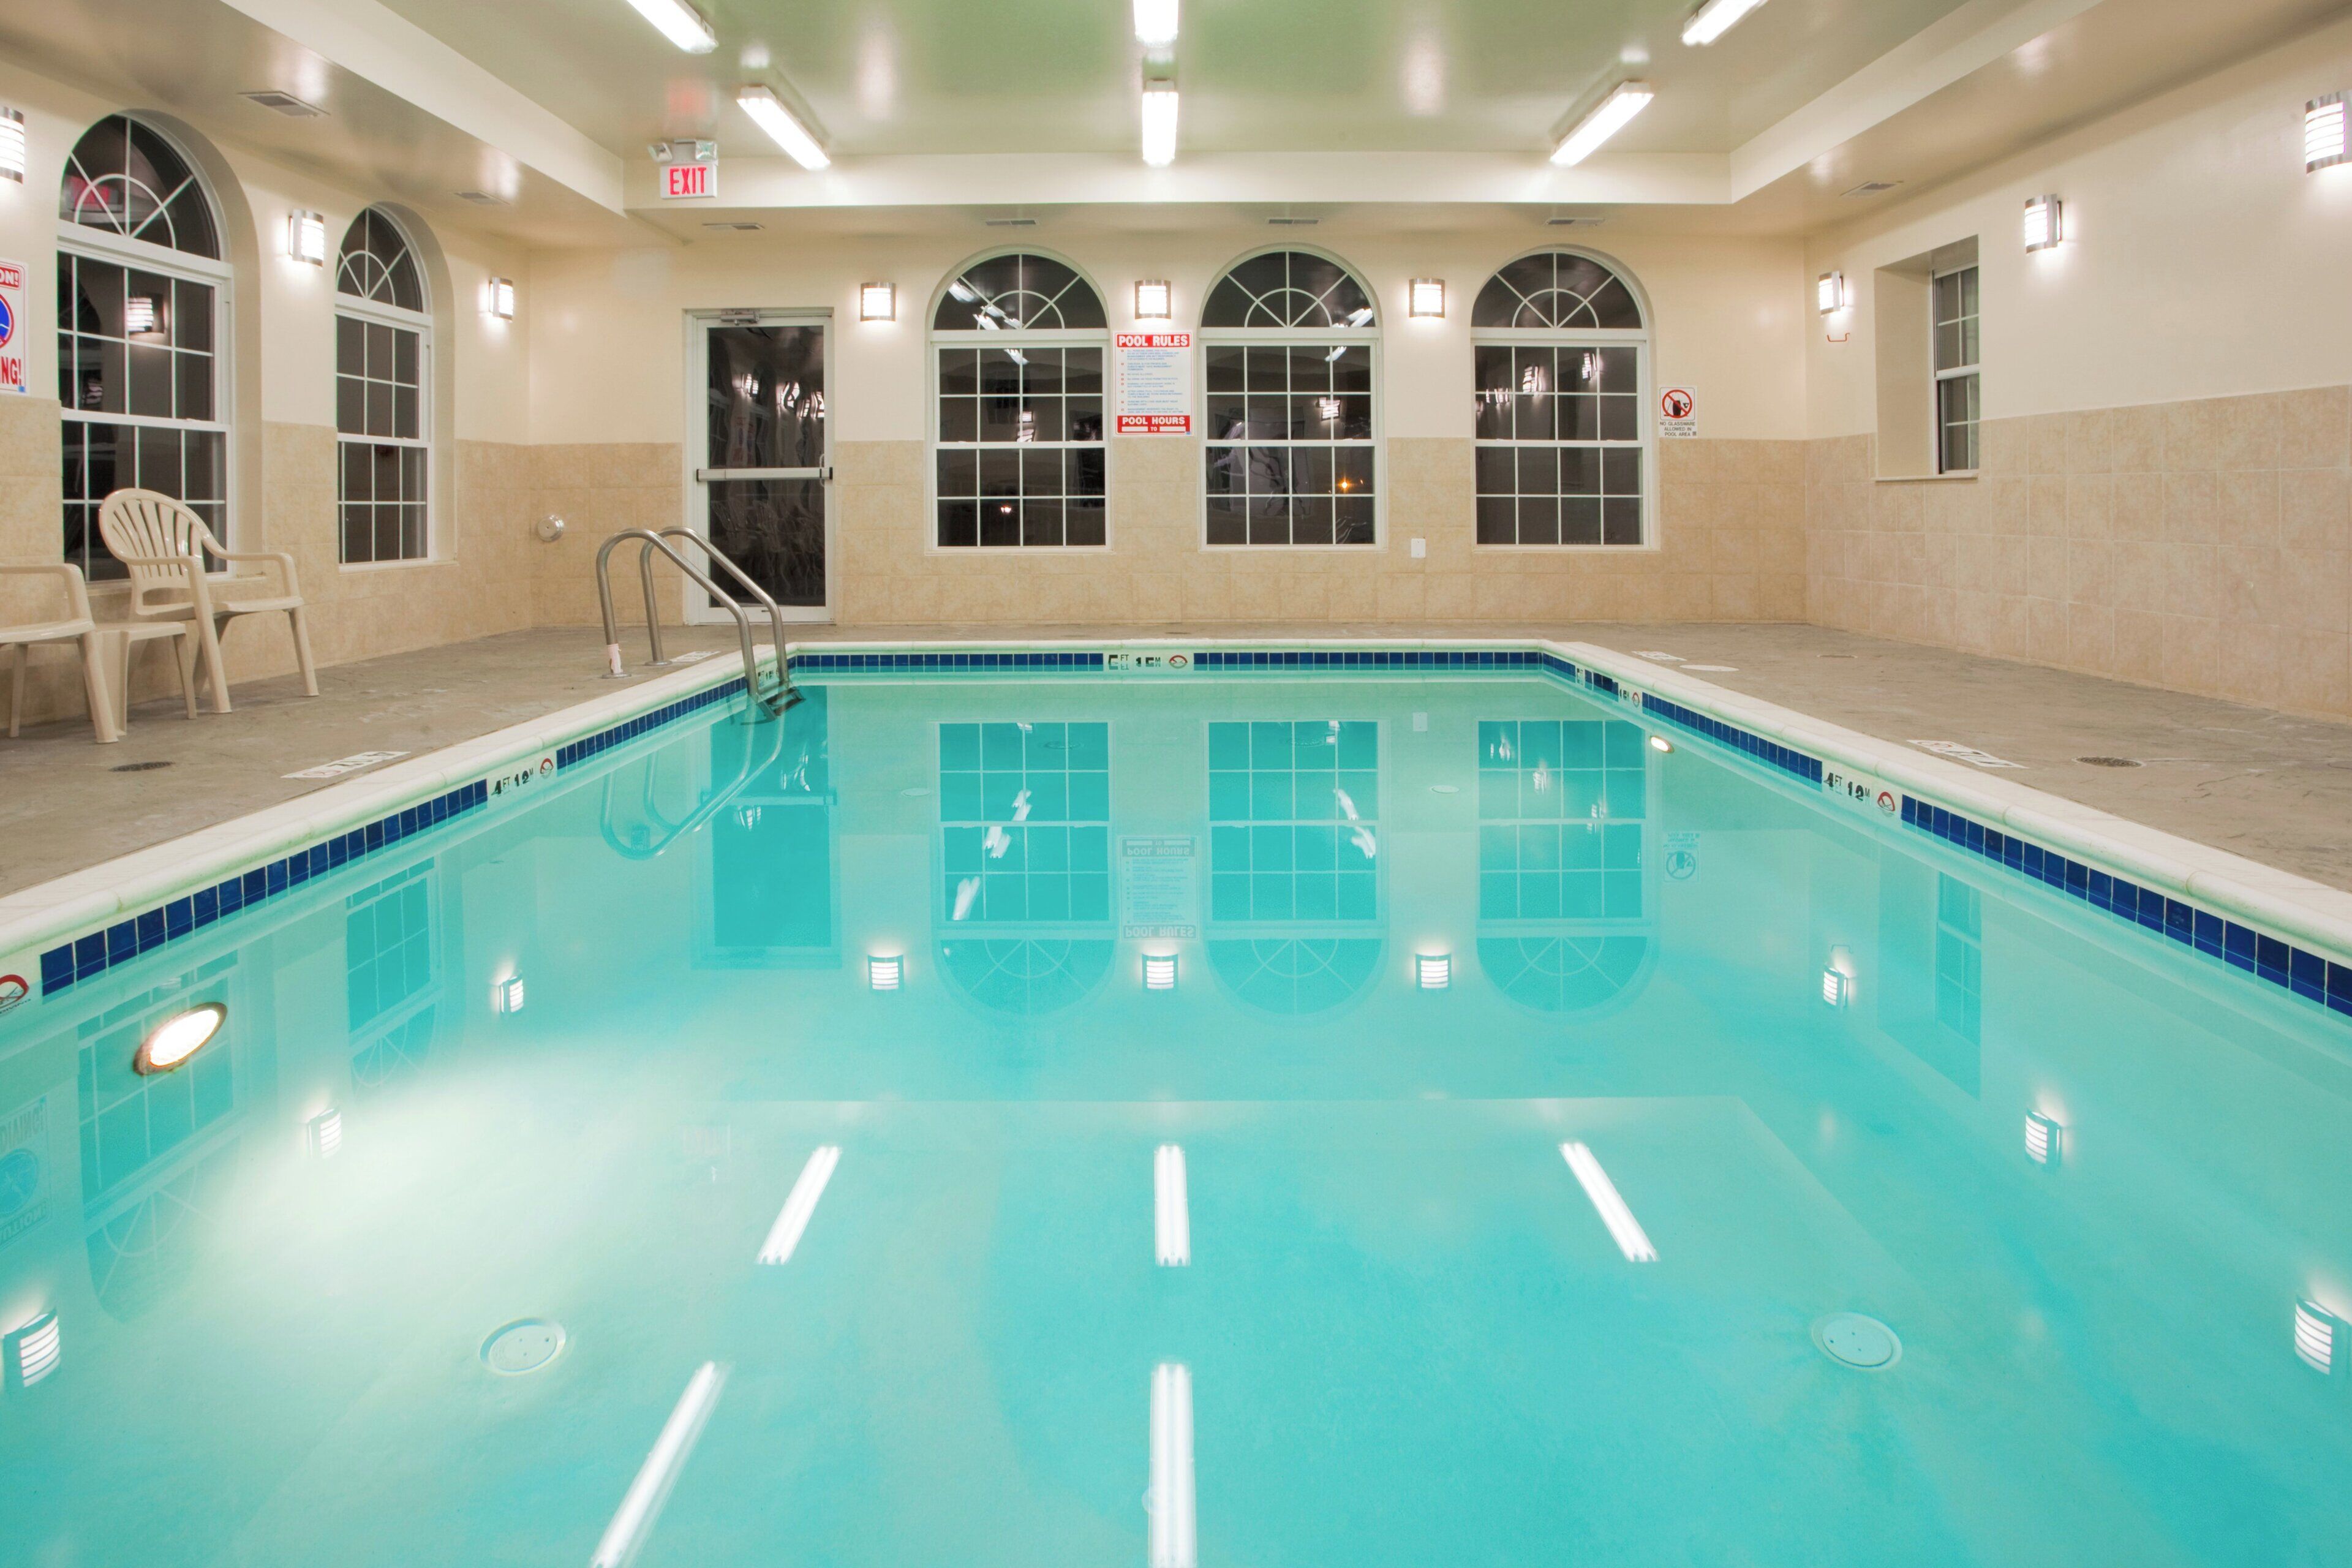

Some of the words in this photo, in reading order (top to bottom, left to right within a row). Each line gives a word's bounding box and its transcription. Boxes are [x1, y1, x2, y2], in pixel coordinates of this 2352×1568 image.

[669, 167, 707, 195] EXIT
[1118, 335, 1148, 347] POOL
[1153, 335, 1188, 347] RULES
